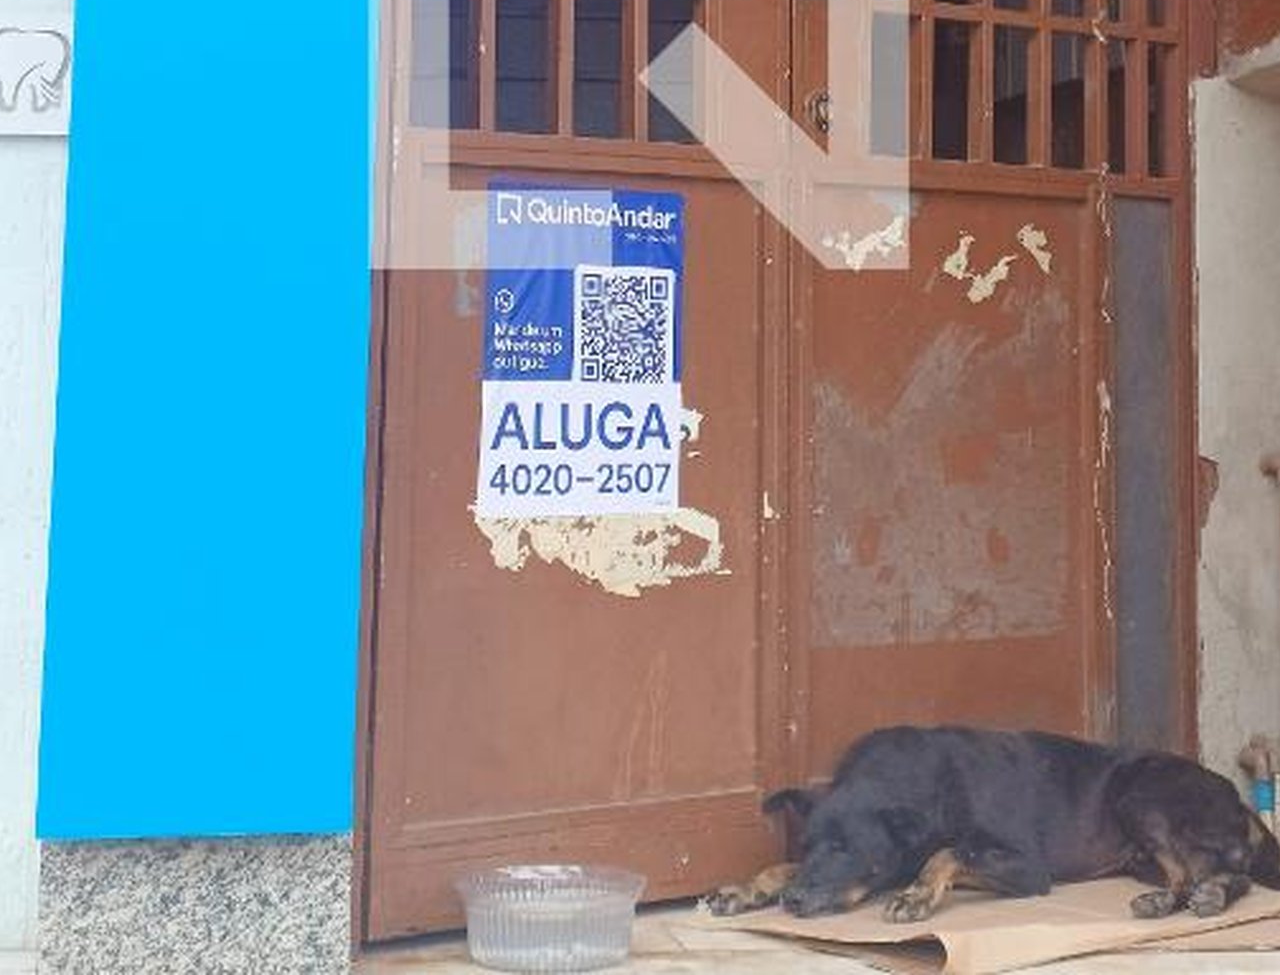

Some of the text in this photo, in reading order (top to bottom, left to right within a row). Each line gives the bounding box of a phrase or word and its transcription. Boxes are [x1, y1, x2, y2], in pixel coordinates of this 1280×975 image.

[527, 199, 677, 230] QuintoAndar
[491, 402, 671, 451] ALUGA
[490, 463, 671, 496] 4020-2507
